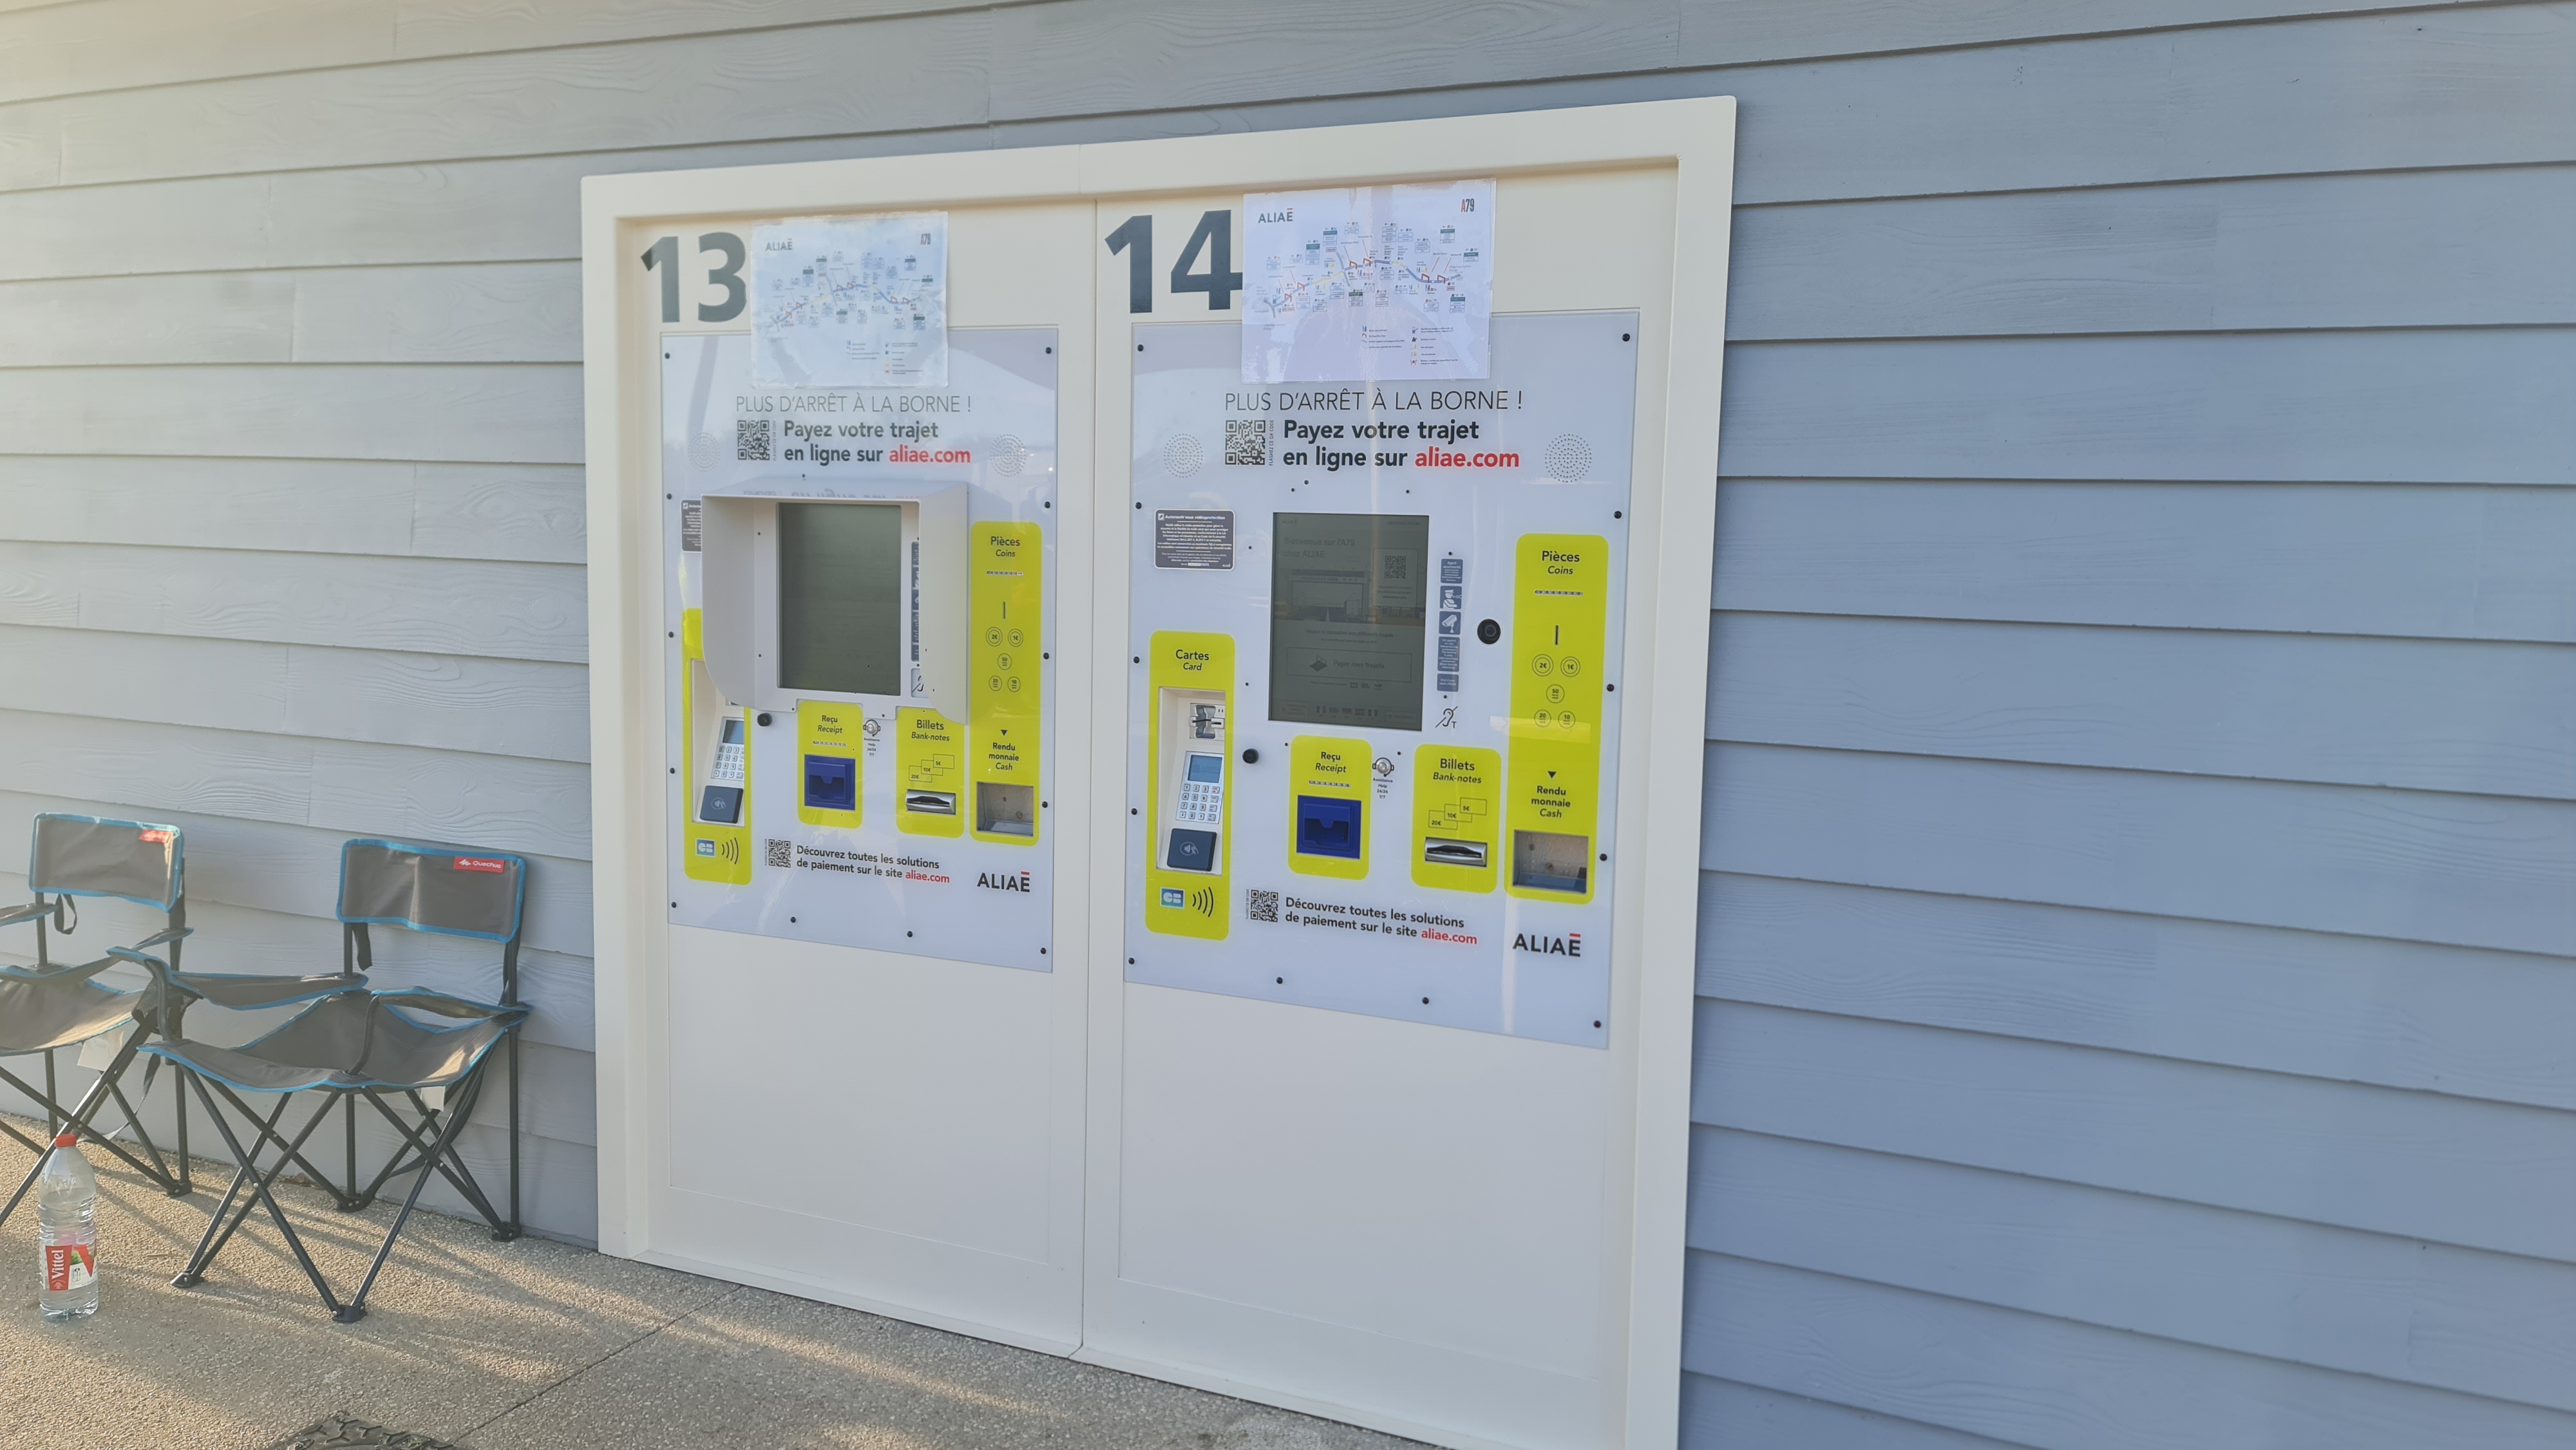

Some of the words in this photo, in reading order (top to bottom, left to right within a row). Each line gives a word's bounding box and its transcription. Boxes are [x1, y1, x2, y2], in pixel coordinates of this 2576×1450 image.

[1461, 198, 1474, 212] A79
[920, 233, 931, 245] A79
[1104, 209, 1243, 314] 14
[640, 232, 747, 323] 13
[737, 396, 773, 412] PLUS
[853, 392, 866, 412] À
[872, 396, 893, 412] LA
[900, 395, 960, 412] BORNE
[967, 395, 971, 412] !
[1225, 393, 1271, 411] PLUS
[1372, 388, 1387, 410] À
[1396, 392, 1423, 410] LA
[1431, 390, 1508, 410] BORNE
[1518, 390, 1522, 409] !
[784, 420, 832, 442] Payez
[838, 422, 884, 438] votre
[890, 421, 938, 444] trajet
[1284, 419, 1344, 444] Payez
[1351, 422, 1410, 438] votre
[1417, 419, 1479, 444] trajet
[784, 447, 804, 461] en
[810, 444, 850, 466] ligne
[857, 447, 883, 462] sur
[889, 444, 971, 463] aliae.com
[1283, 450, 1307, 466] en
[1316, 446, 1367, 471] ligne
[1374, 450, 1408, 467] sur
[1415, 446, 1519, 467] aliae.com
[990, 536, 1021, 547] Pièces
[1284, 538, 1321, 546] Bienvenue
[1302, 550, 1325, 558] ALIAE
[1542, 551, 1580, 562] Pièces
[1548, 565, 1573, 574] Coins
[1175, 649, 1209, 661] Cartes
[1183, 662, 1202, 671] Card
[822, 715, 838, 724] Reçu
[916, 719, 944, 730] Billets
[817, 724, 843, 735] Receipt
[911, 732, 950, 741] Bank-notes
[992, 742, 1016, 751] Rendu
[1321, 751, 1341, 762] Reçu
[996, 762, 1013, 771] Cash
[1315, 762, 1347, 775] Receipt
[1440, 758, 1475, 771] Billets
[1433, 772, 1482, 784] Bank-notes
[1537, 786, 1566, 796] Rendu
[1531, 798, 1571, 807] monnaie
[1540, 809, 1562, 818] Cash
[796, 844, 846, 860] Découvrez
[848, 851, 878, 864] toutes
[880, 853, 894, 865] les
[896, 856, 940, 869] solutions
[473, 860, 501, 869] Quechua
[796, 858, 808, 869] de
[811, 860, 854, 874] paiement
[857, 865, 872, 875] sur
[874, 866, 884, 876] le
[886, 867, 903, 878] site
[905, 870, 950, 884] aliae.com
[1285, 896, 1346, 914] Découvrez
[1349, 905, 1387, 919] toutes
[1390, 909, 1406, 921] les
[1410, 912, 1464, 928] solutions
[1285, 911, 1300, 923] de
[1303, 914, 1357, 930] paiement
[1360, 921, 1378, 932] sur
[1382, 922, 1393, 934] le
[1396, 925, 1417, 937] site
[1421, 928, 1478, 945] aliae.com
[52, 1249, 64, 1279] Vittel
